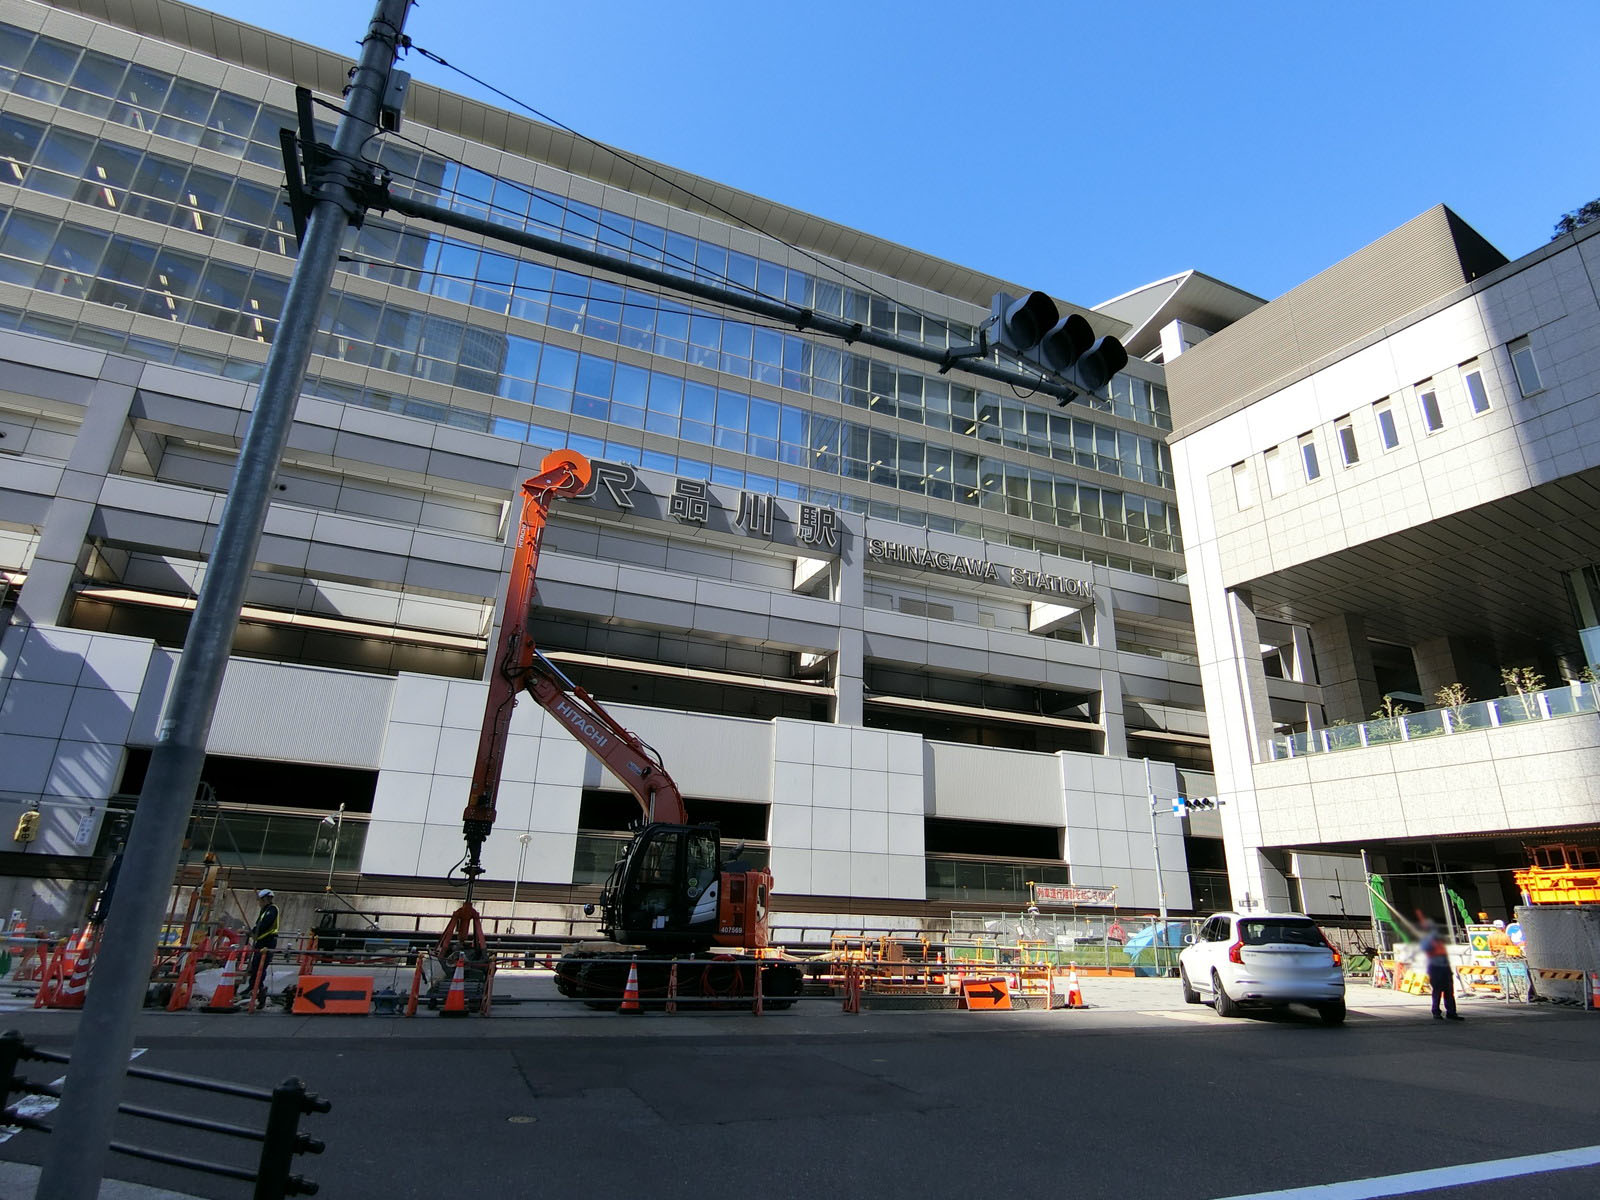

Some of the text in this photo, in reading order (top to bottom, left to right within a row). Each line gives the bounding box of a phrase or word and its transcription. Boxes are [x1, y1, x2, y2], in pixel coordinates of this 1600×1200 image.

[576, 460, 837, 548] JR 品川駅
[518, 524, 526, 548] HITACHI
[869, 539, 1093, 598] SHINAGAWA STATION
[558, 702, 607, 746] HITACHI
